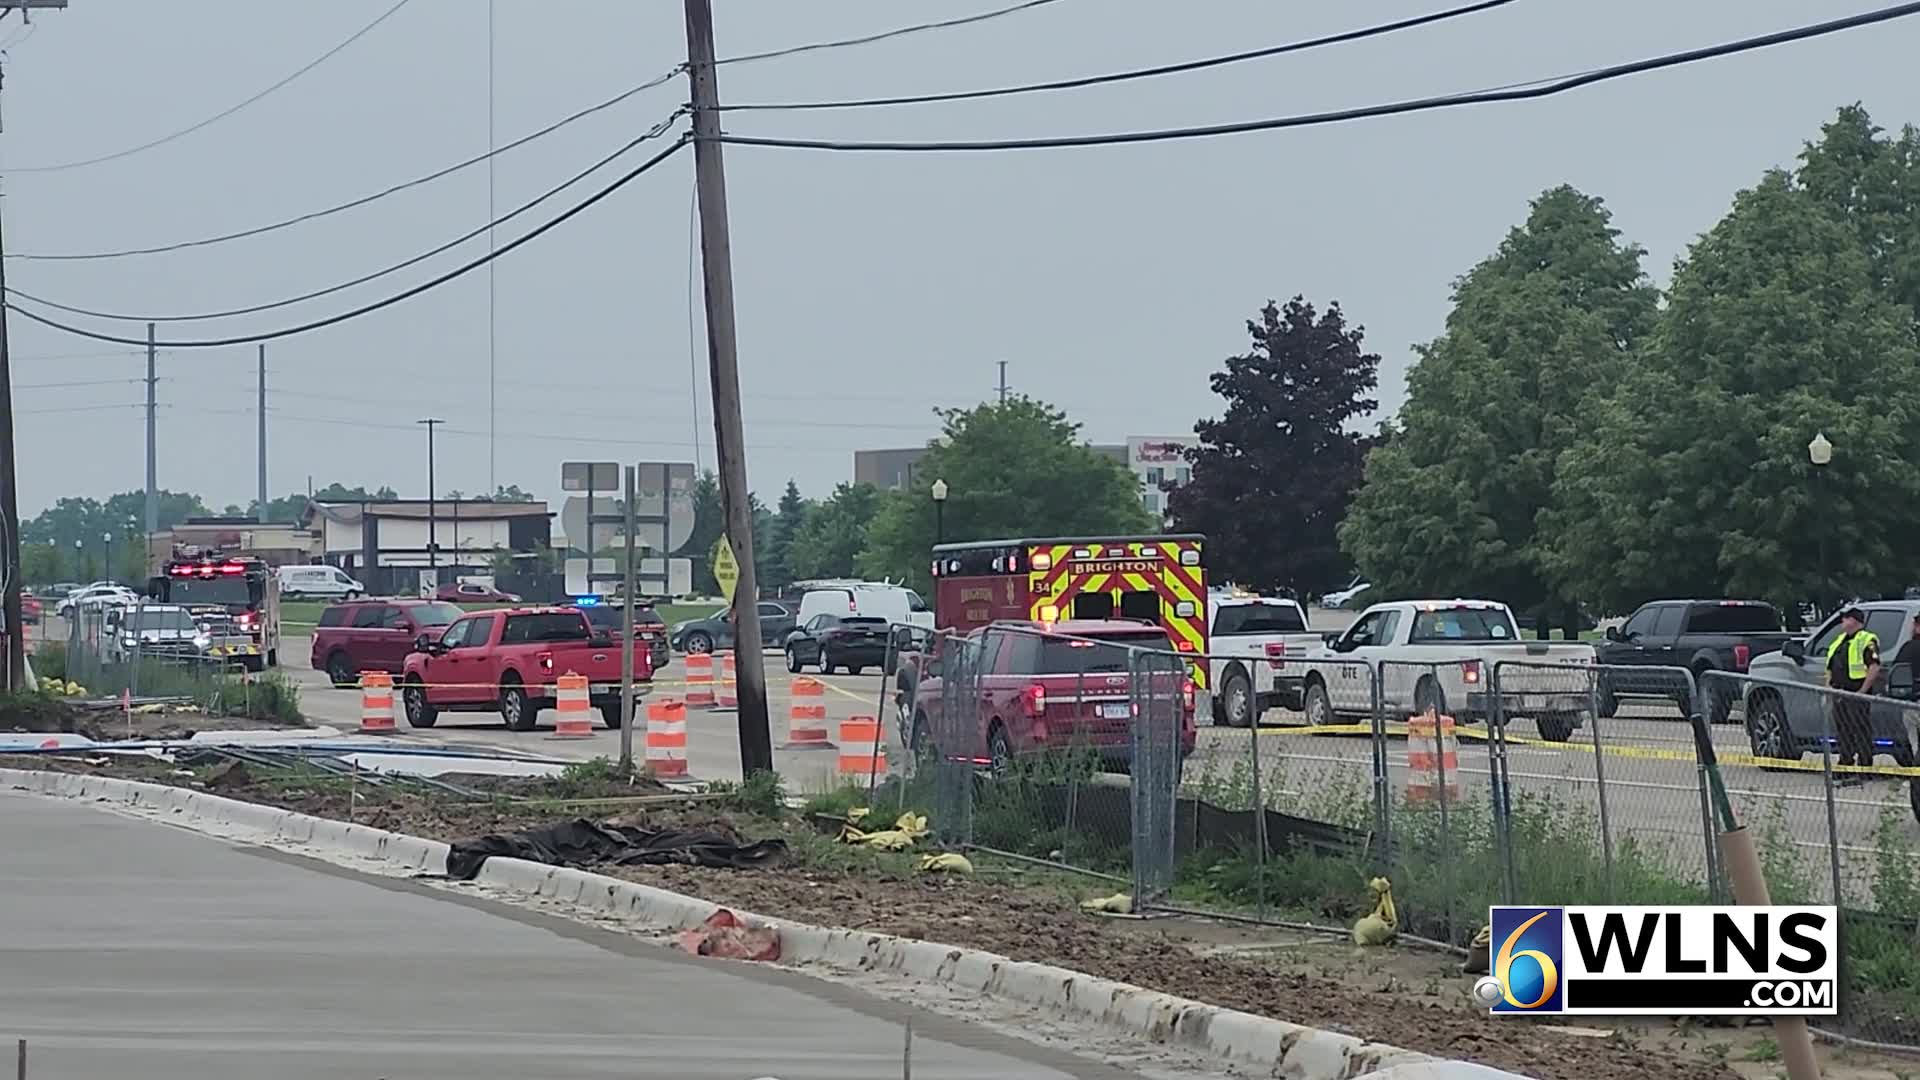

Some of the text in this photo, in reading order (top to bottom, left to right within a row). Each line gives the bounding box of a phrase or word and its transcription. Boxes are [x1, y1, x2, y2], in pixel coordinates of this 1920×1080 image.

[1075, 562, 1157, 574] BRIGHTON
[1034, 582, 1050, 593] 34
[1342, 666, 1358, 679] DTE
